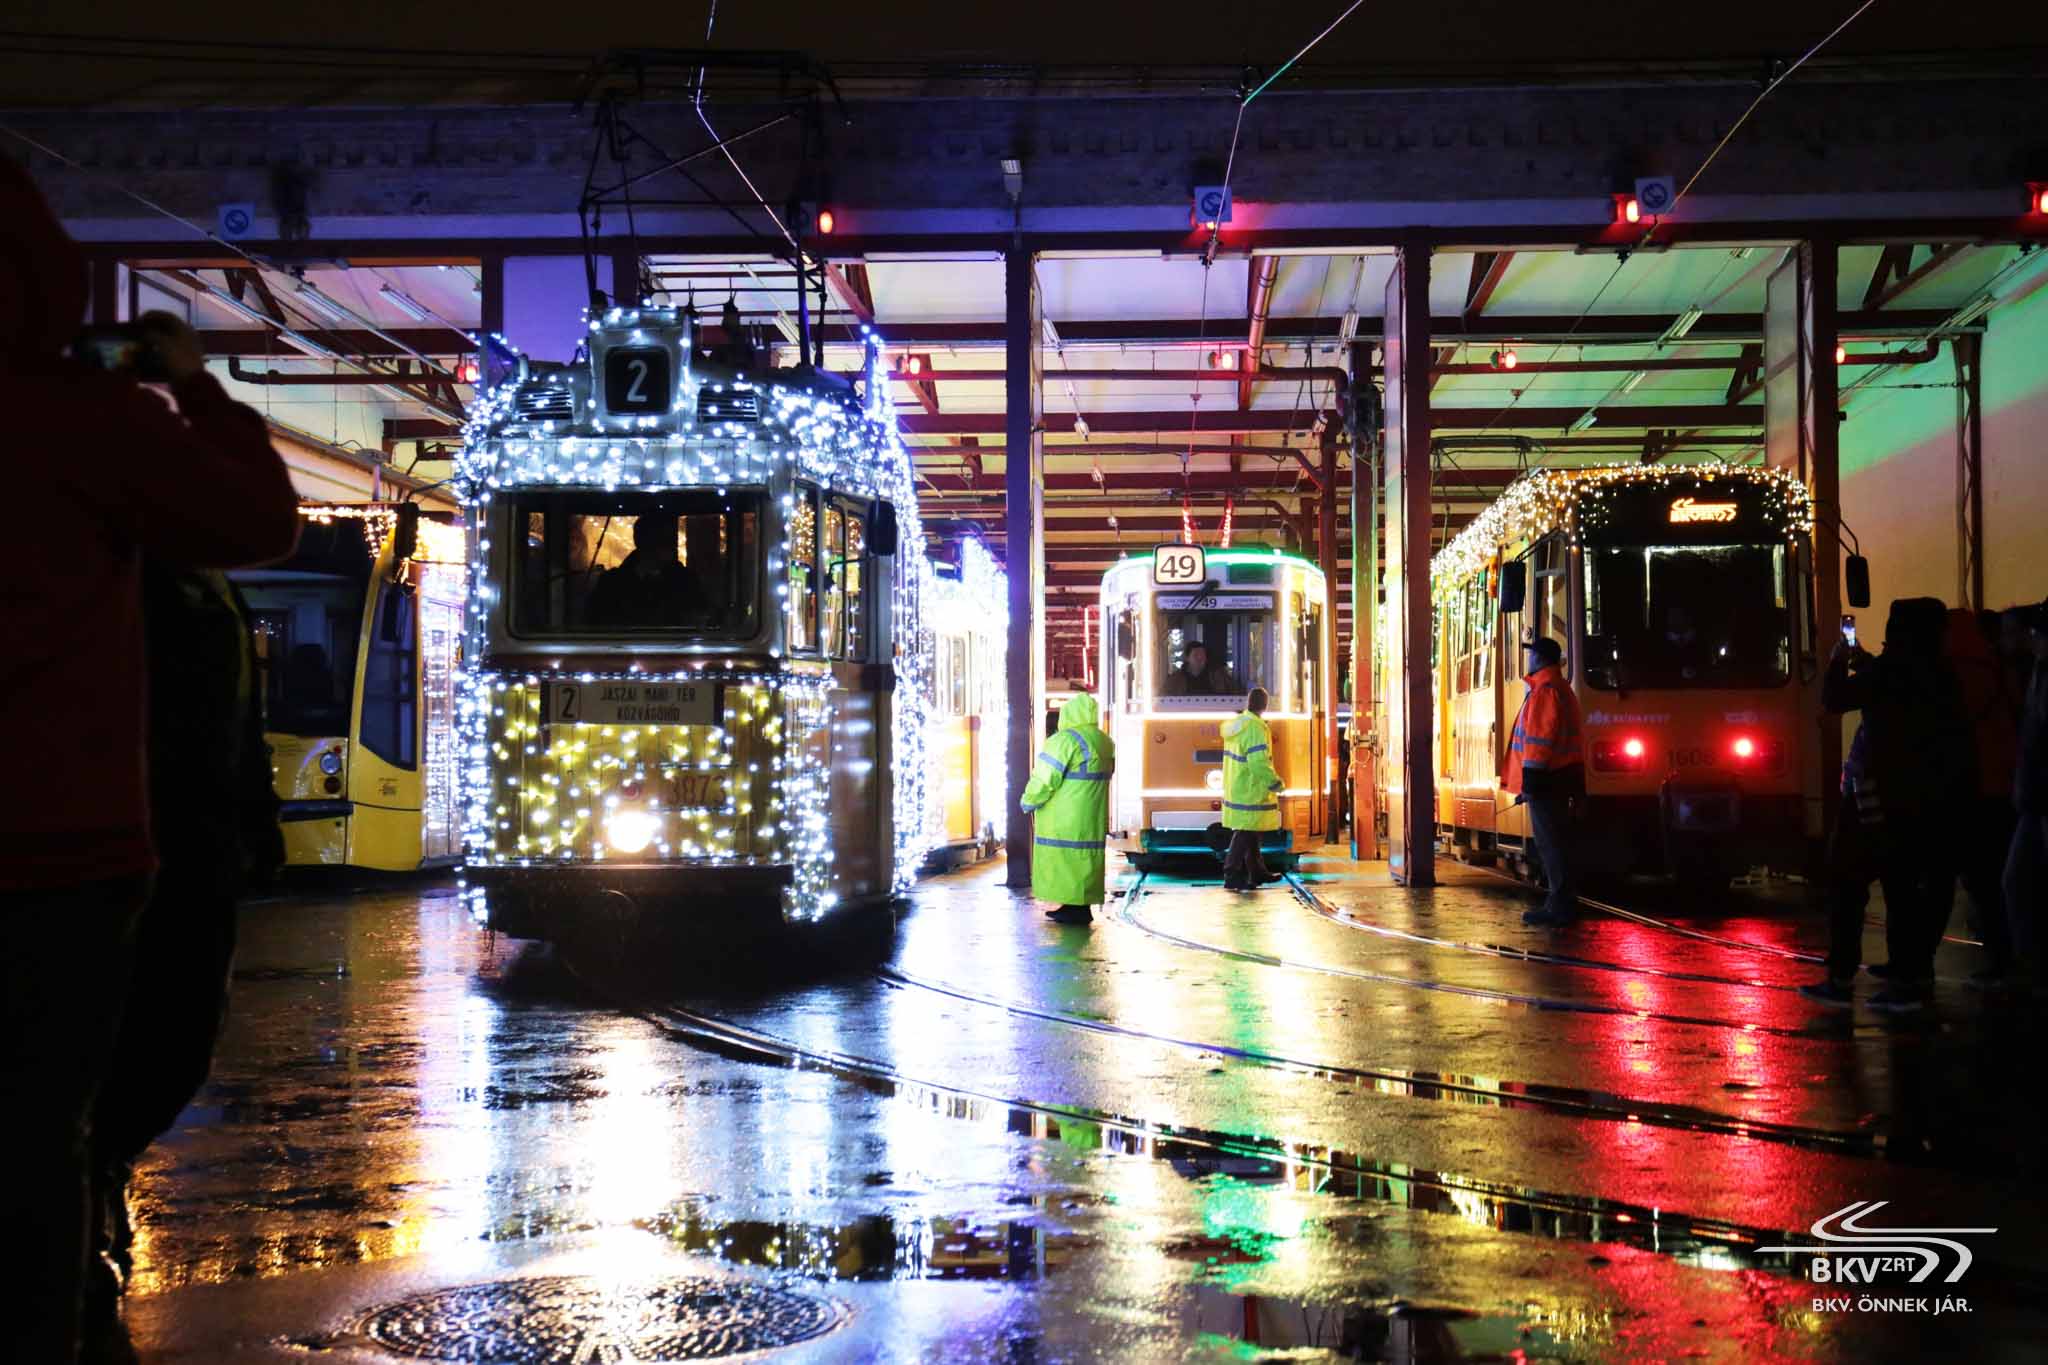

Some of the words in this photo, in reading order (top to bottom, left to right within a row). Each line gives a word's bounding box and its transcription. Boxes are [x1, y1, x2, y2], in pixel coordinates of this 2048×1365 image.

[626, 359, 648, 402] 2
[1159, 554, 1196, 578] 49
[1201, 597, 1217, 608] 49
[561, 687, 575, 718] 2
